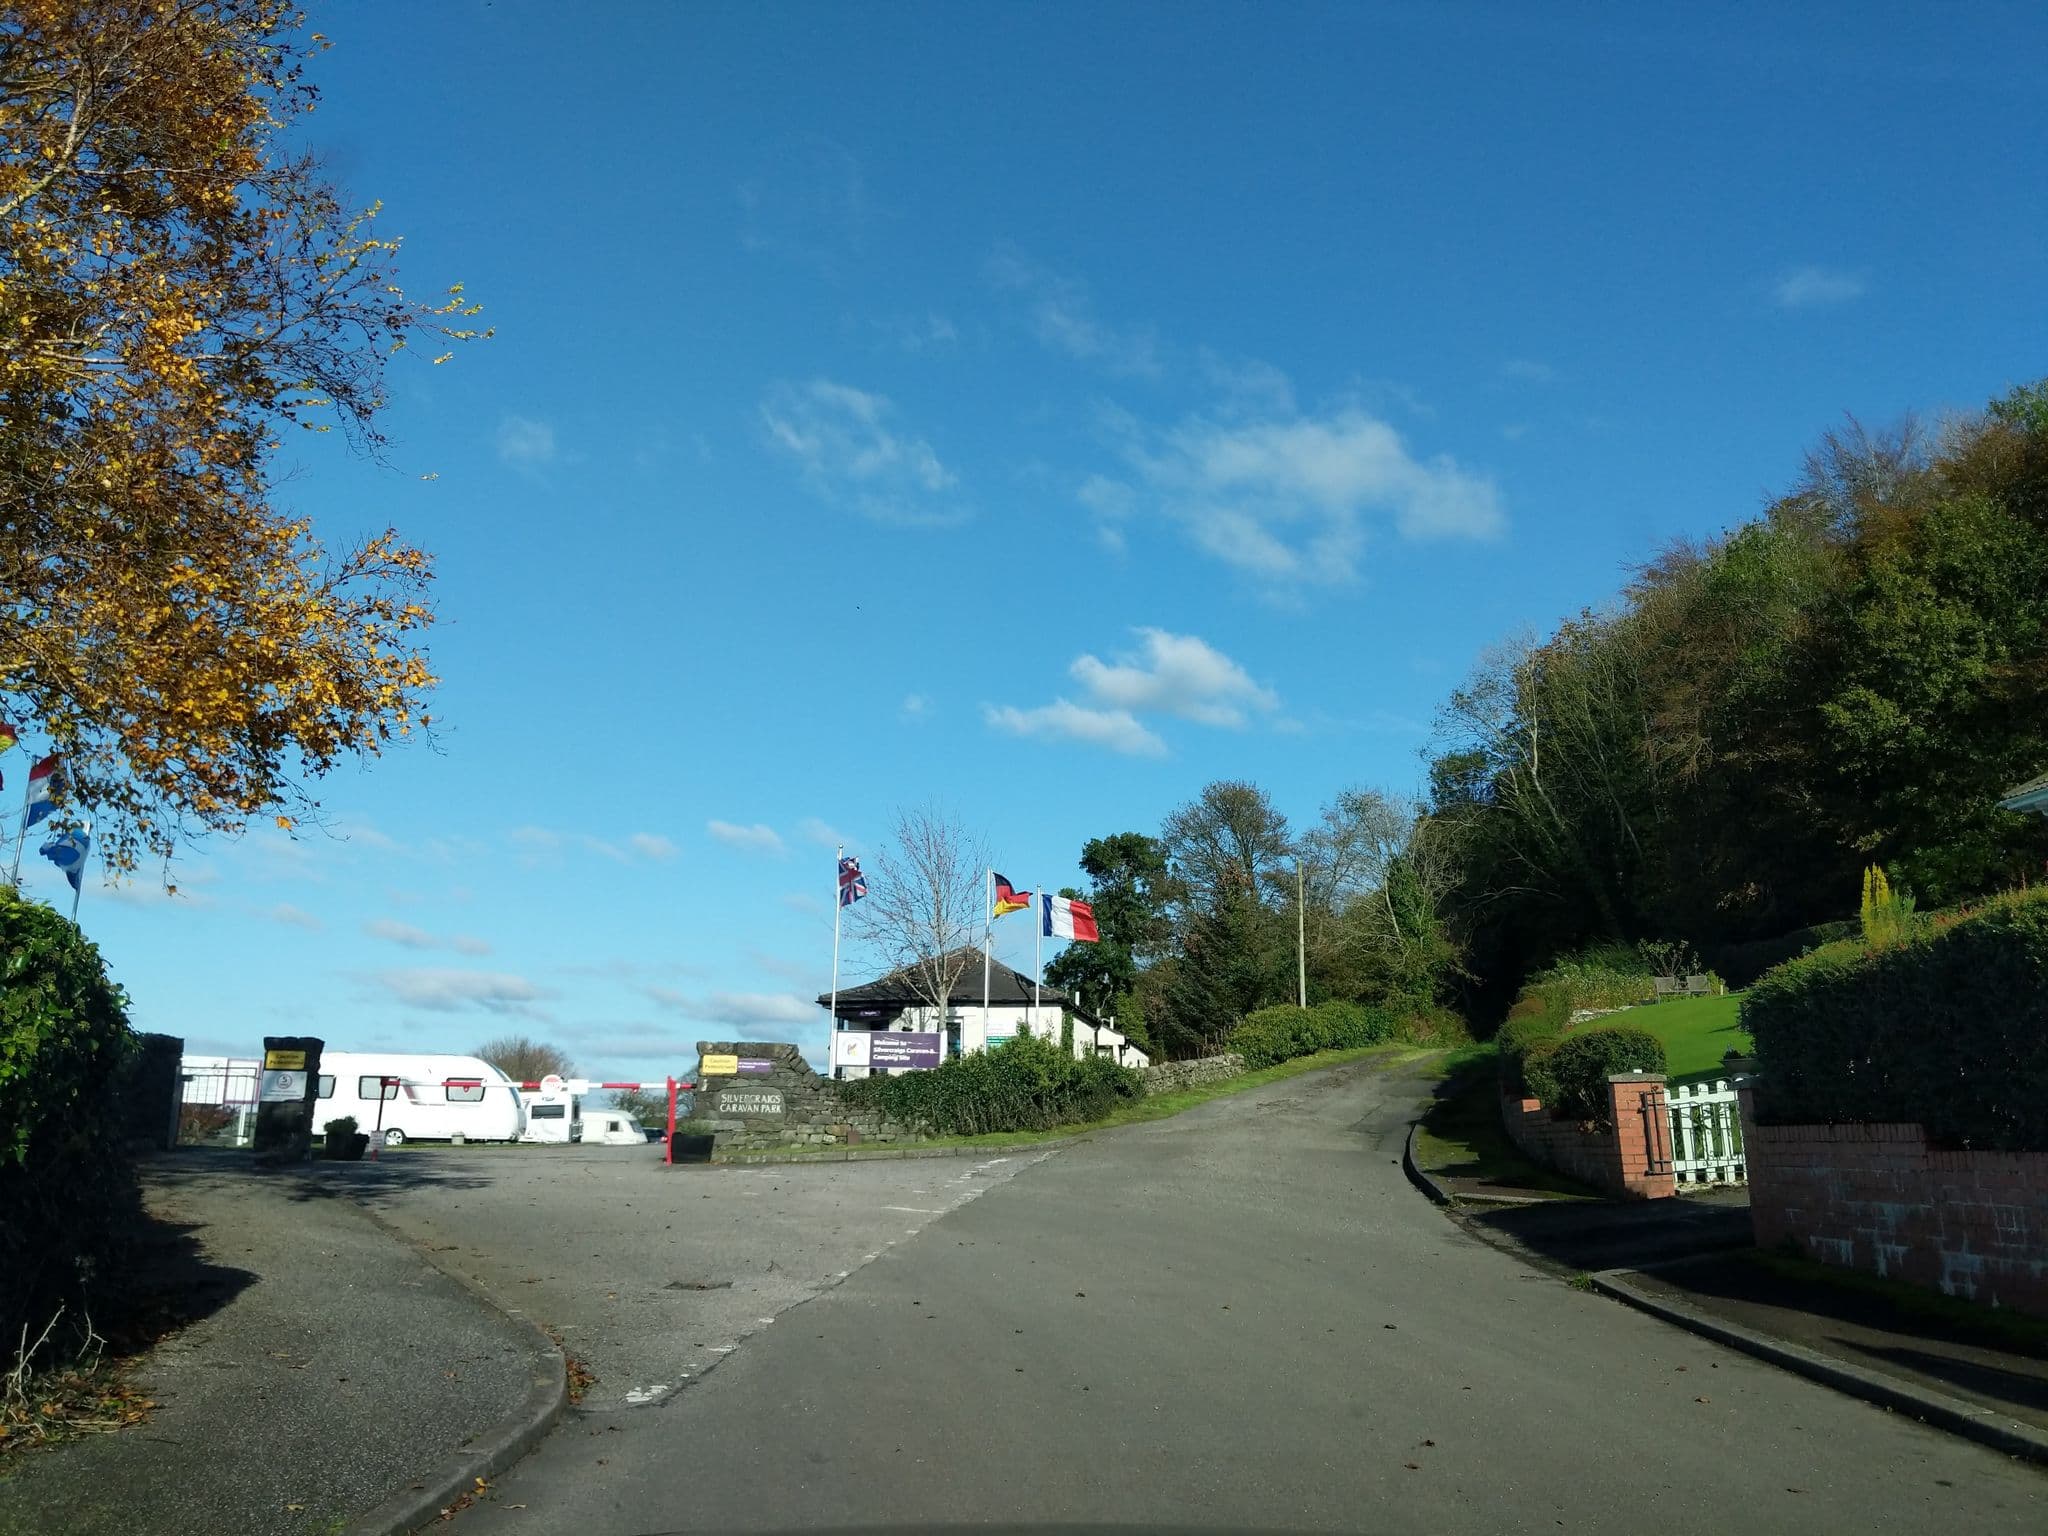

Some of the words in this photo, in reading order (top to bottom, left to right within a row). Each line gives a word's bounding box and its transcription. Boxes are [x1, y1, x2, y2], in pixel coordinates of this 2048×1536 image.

[873, 1054, 898, 1062] Camping
[720, 1103, 760, 1113] CARAVAN
[761, 1104, 782, 1113] PARK
